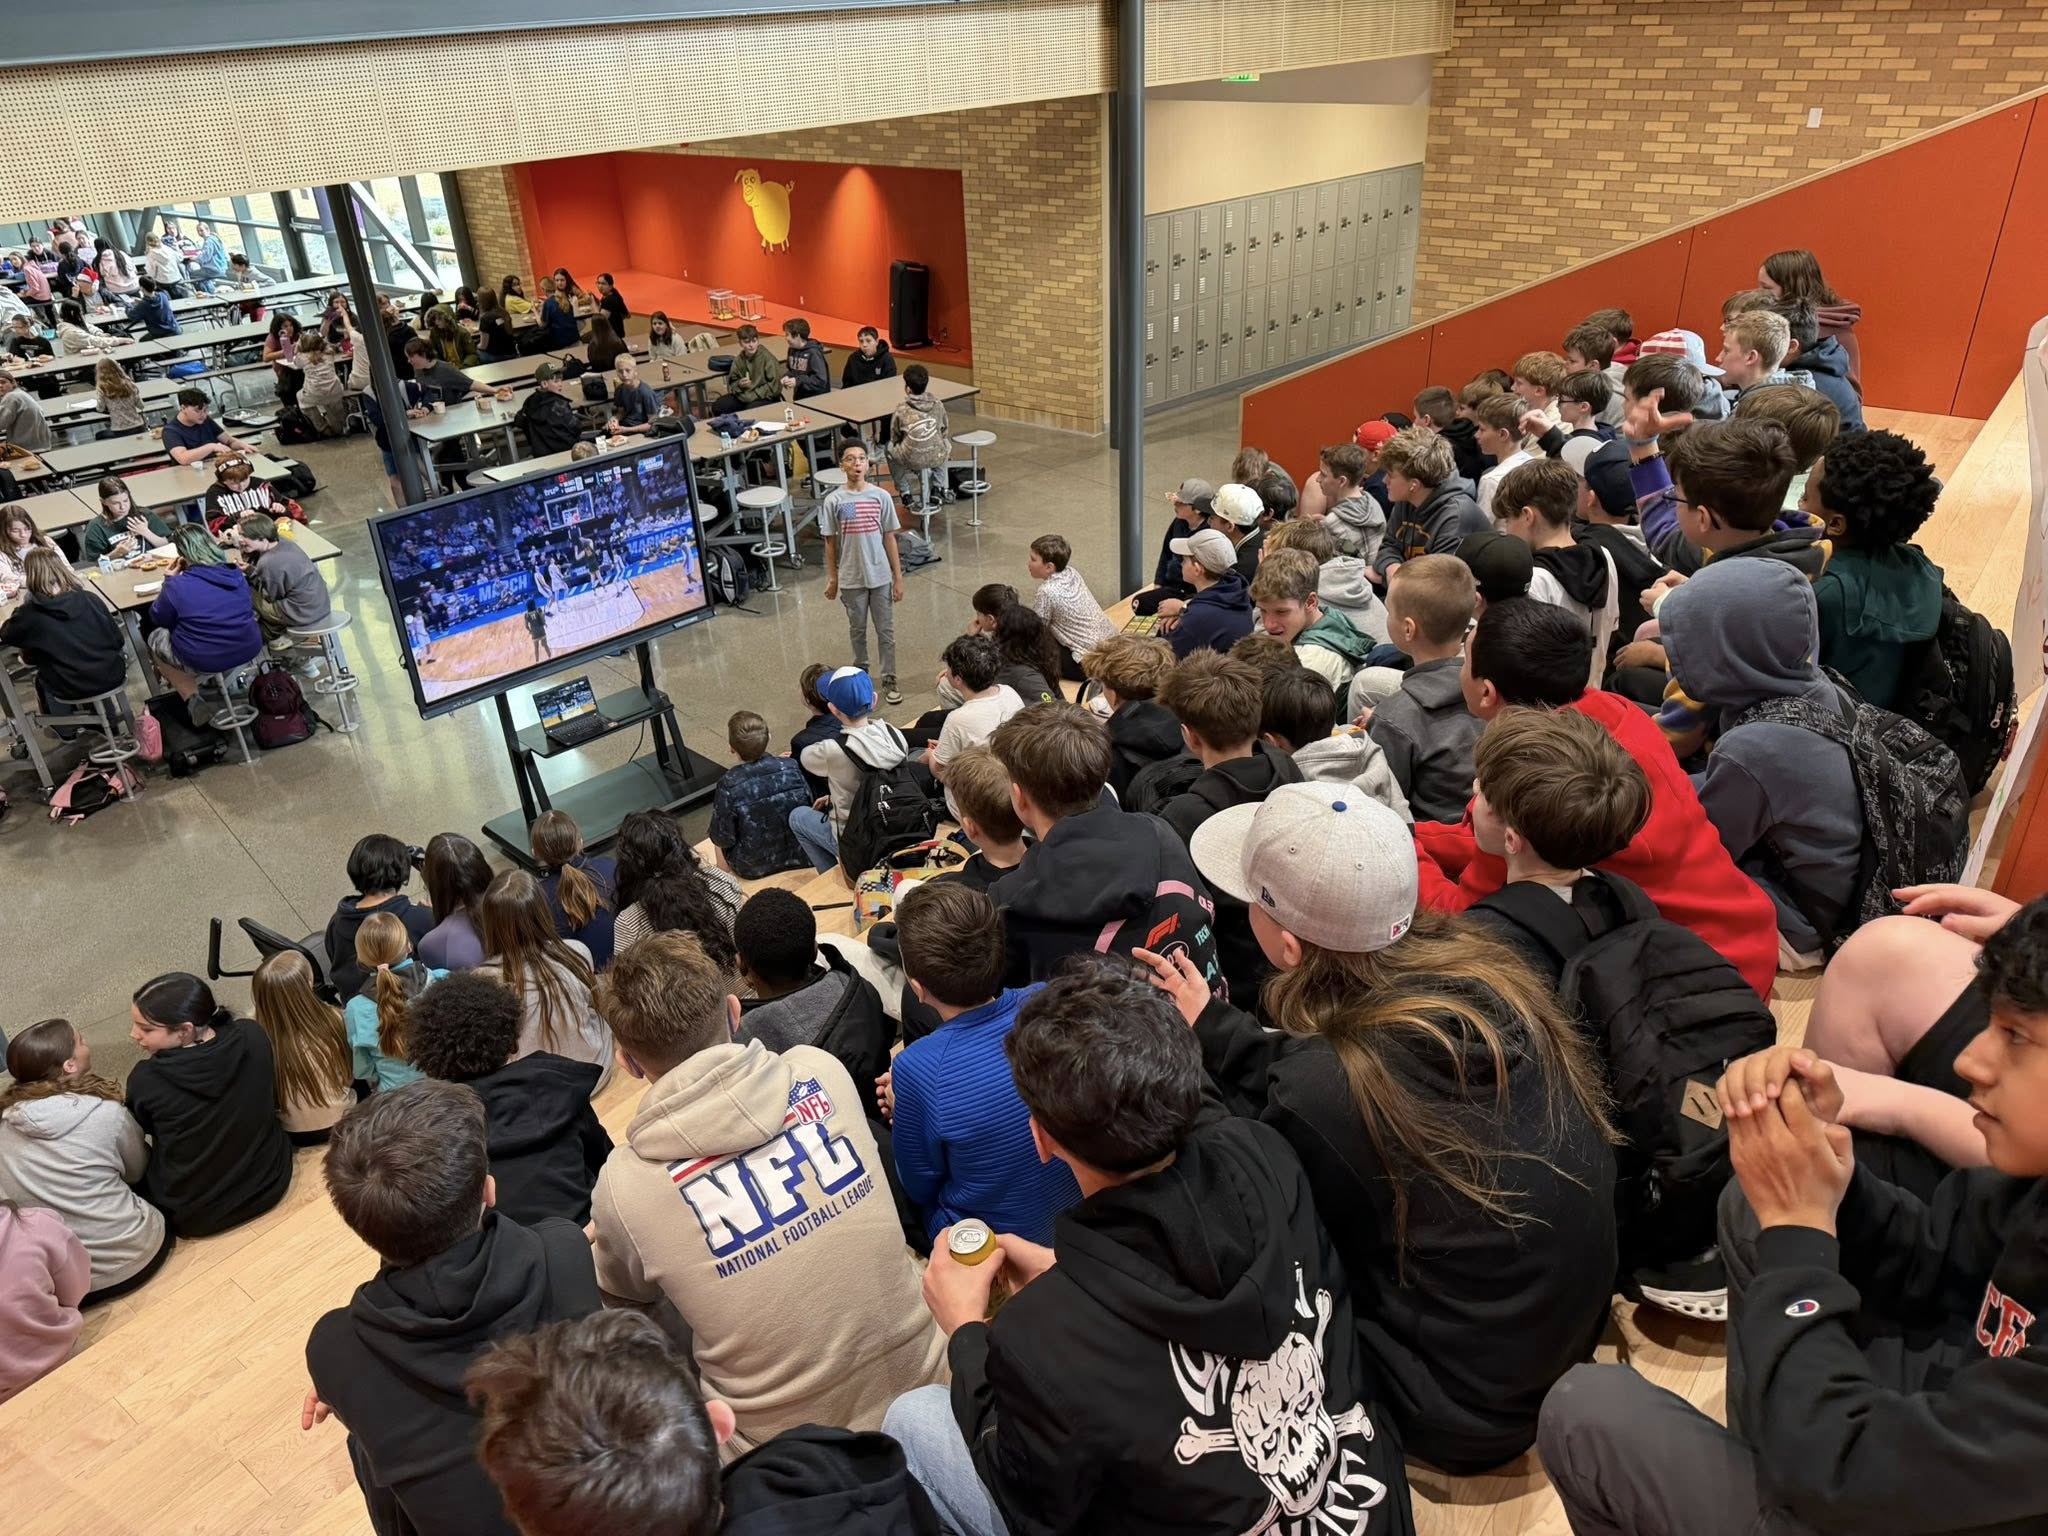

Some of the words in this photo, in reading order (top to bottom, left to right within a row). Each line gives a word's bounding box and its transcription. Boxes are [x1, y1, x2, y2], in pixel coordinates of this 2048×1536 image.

[217, 487, 269, 516] SHADOW
[799, 1093, 830, 1123] NFL
[679, 1122, 866, 1258] NFL
[715, 1236, 782, 1279] NATIONAL
[782, 1199, 842, 1246] FOOTBALL
[841, 1174, 874, 1209] LEAGUE
